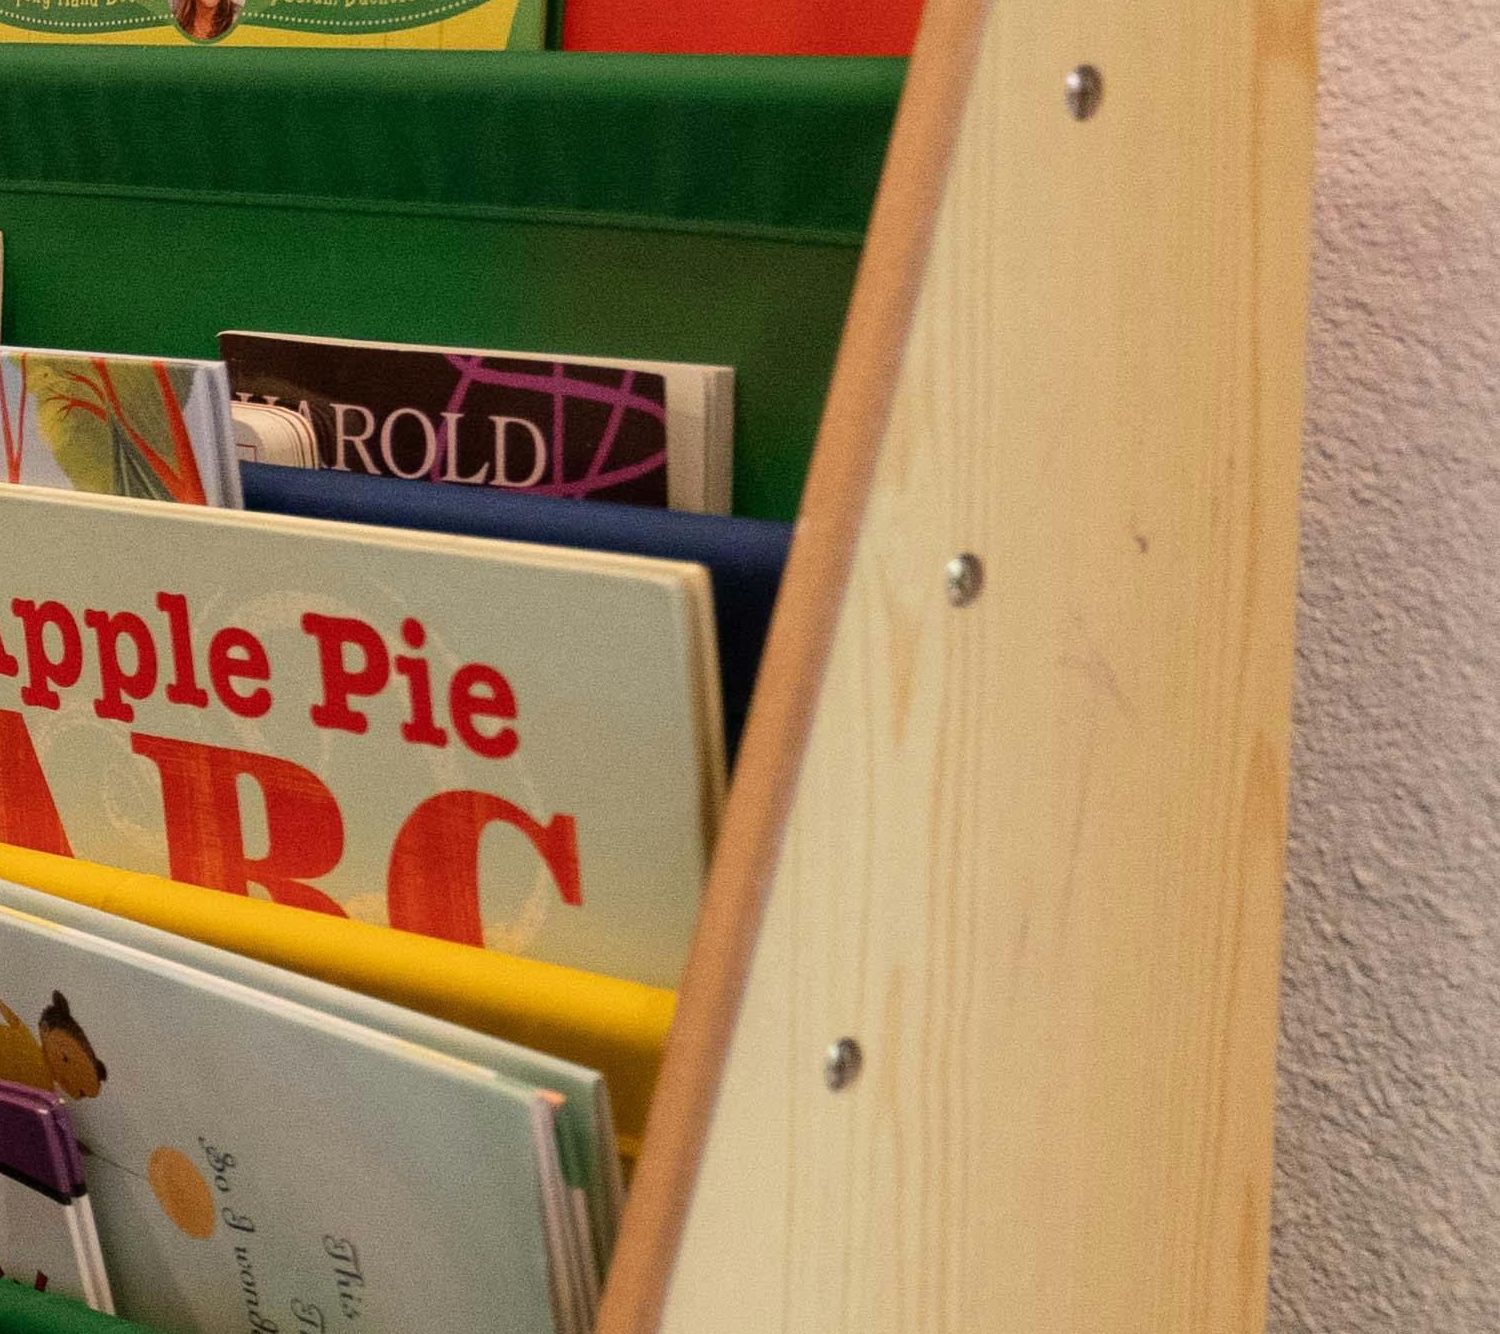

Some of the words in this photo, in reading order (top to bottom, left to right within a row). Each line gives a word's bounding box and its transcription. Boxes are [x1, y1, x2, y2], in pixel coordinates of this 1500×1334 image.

[301, 613, 519, 758] Pie
[198, 1136, 235, 1192] So
[324, 1235, 365, 1318] This
